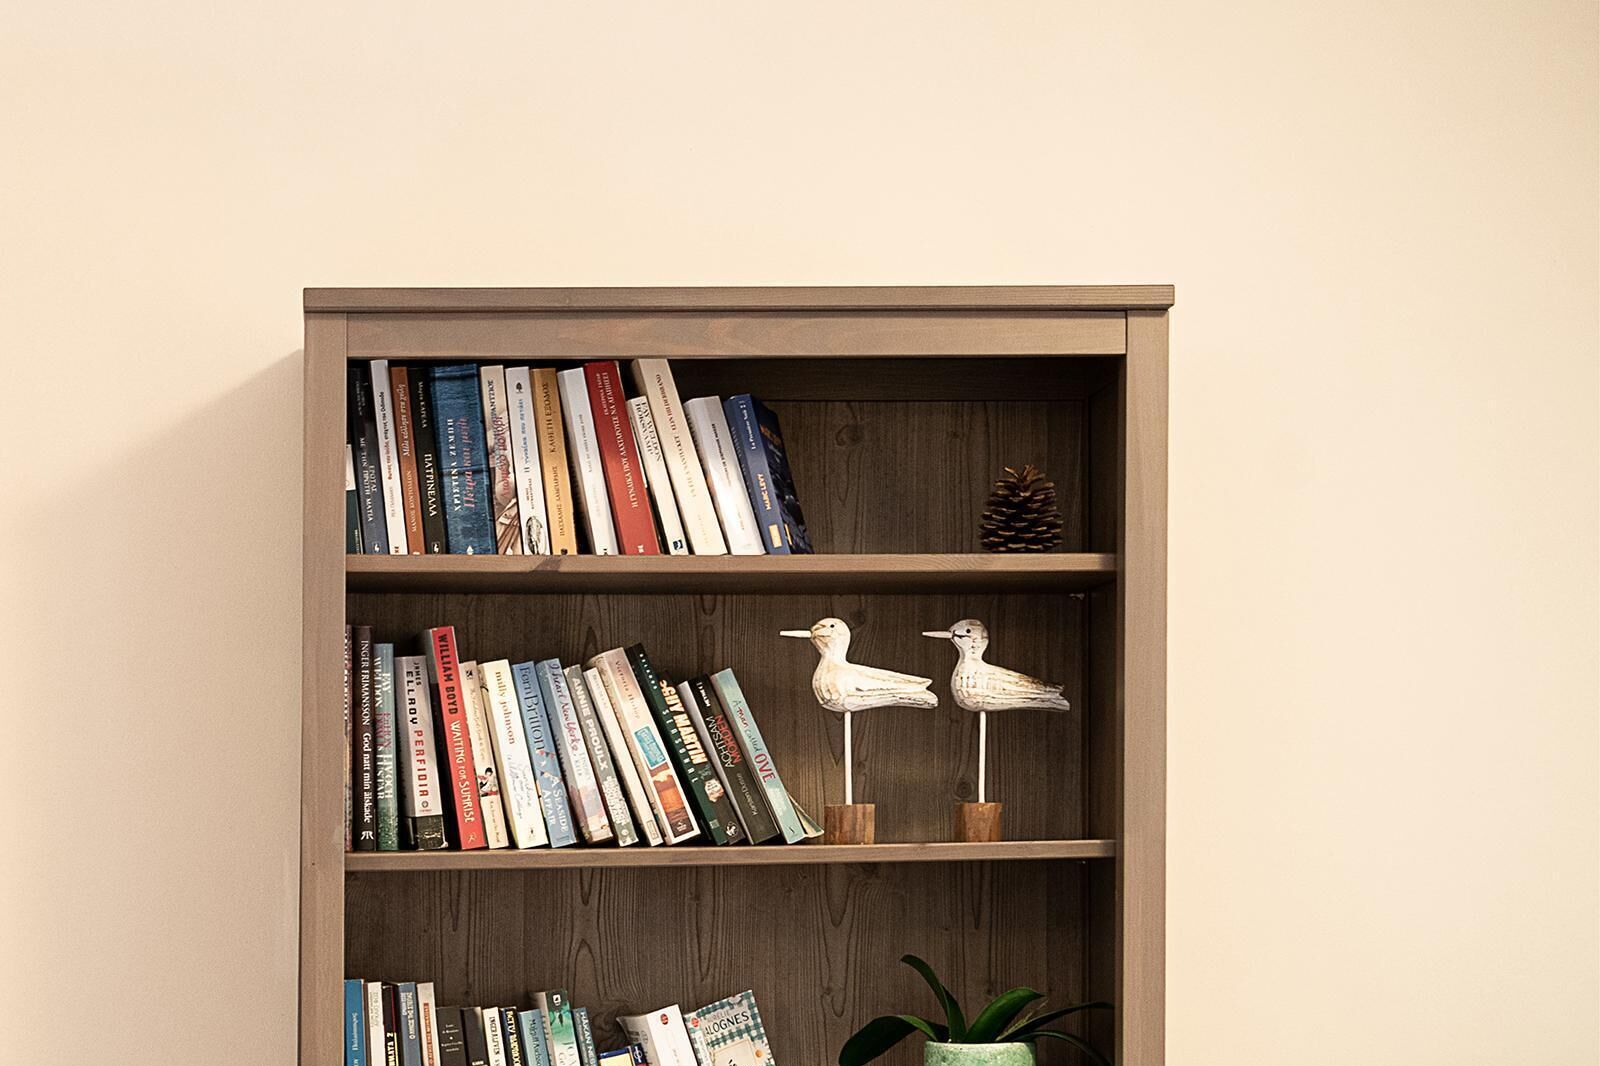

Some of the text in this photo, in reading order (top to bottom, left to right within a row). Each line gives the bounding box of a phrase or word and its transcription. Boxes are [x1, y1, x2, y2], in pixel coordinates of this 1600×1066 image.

[542, 382, 557, 453] ΚΑΘΕΤΗ ΕΞΟΔΟΣ
[424, 454, 437, 516] ΠΑΤΡΙΝΕΛΛΑ
[447, 418, 462, 511] ΧΡΙΣΤΙΝΑ ΖΕΜΠΗ
[756, 473, 772, 510] MARC LEVY
[360, 640, 370, 726] INGER FRIMANSSON
[374, 657, 383, 708] WELDON
[382, 673, 391, 694] FAY
[406, 671, 418, 725] ELLROY
[413, 662, 422, 687] JAMES
[438, 634, 458, 715] WILLIAM BOYD
[661, 685, 685, 714] GUY
[494, 671, 516, 745] milly johnson
[519, 667, 546, 751] Fern Britton
[572, 677, 593, 717] ANNIE
[585, 719, 608, 771] PROULX
[414, 730, 429, 798] PERFIDIA
[671, 713, 707, 766] MARTIN
[706, 715, 735, 768] ACHTSAM
[712, 714, 742, 764] MORDEN
[736, 707, 749, 729] man
[744, 729, 762, 752] called
[754, 753, 776, 784] OVE
[362, 733, 372, 824] God natt min älskade
[449, 720, 466, 764] WAITING
[458, 781, 474, 824] SUNRISE
[541, 789, 555, 827] AFFAIR
[550, 776, 569, 833] A SEASIDE
[580, 1011, 594, 1044] HÅKAN
